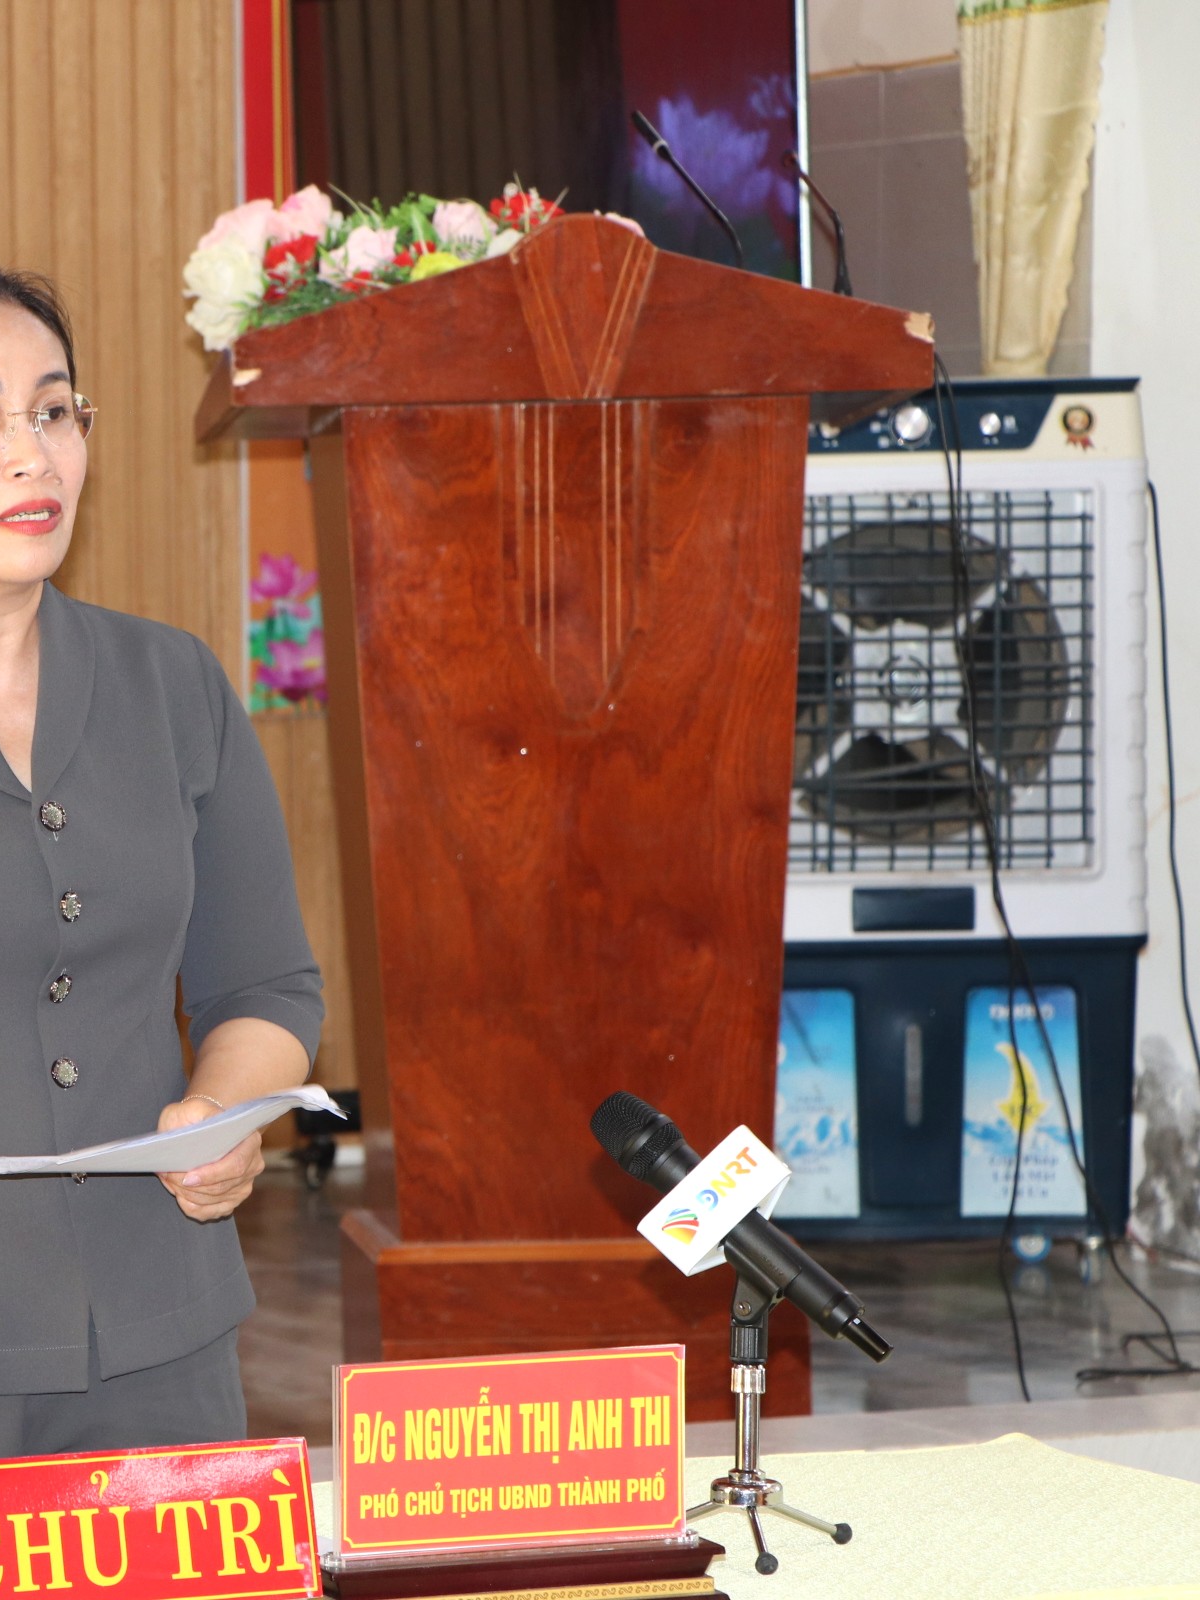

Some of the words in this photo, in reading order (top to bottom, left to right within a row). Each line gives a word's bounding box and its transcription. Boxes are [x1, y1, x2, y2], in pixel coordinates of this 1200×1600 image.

[353, 1411, 396, 1464] Đ/c
[404, 1386, 511, 1461] NGUYỄN
[519, 1402, 560, 1464] THỊ
[567, 1398, 623, 1451] ANH
[630, 1395, 671, 1447] THI
[155, 1468, 305, 1581] TRÌ
[359, 1488, 399, 1519] PHÓ
[405, 1482, 444, 1516] CHỦ
[450, 1487, 492, 1518] TỊCH
[499, 1483, 552, 1511] UBND
[557, 1476, 621, 1507] THÀNH
[627, 1468, 666, 1502] PHỐ
